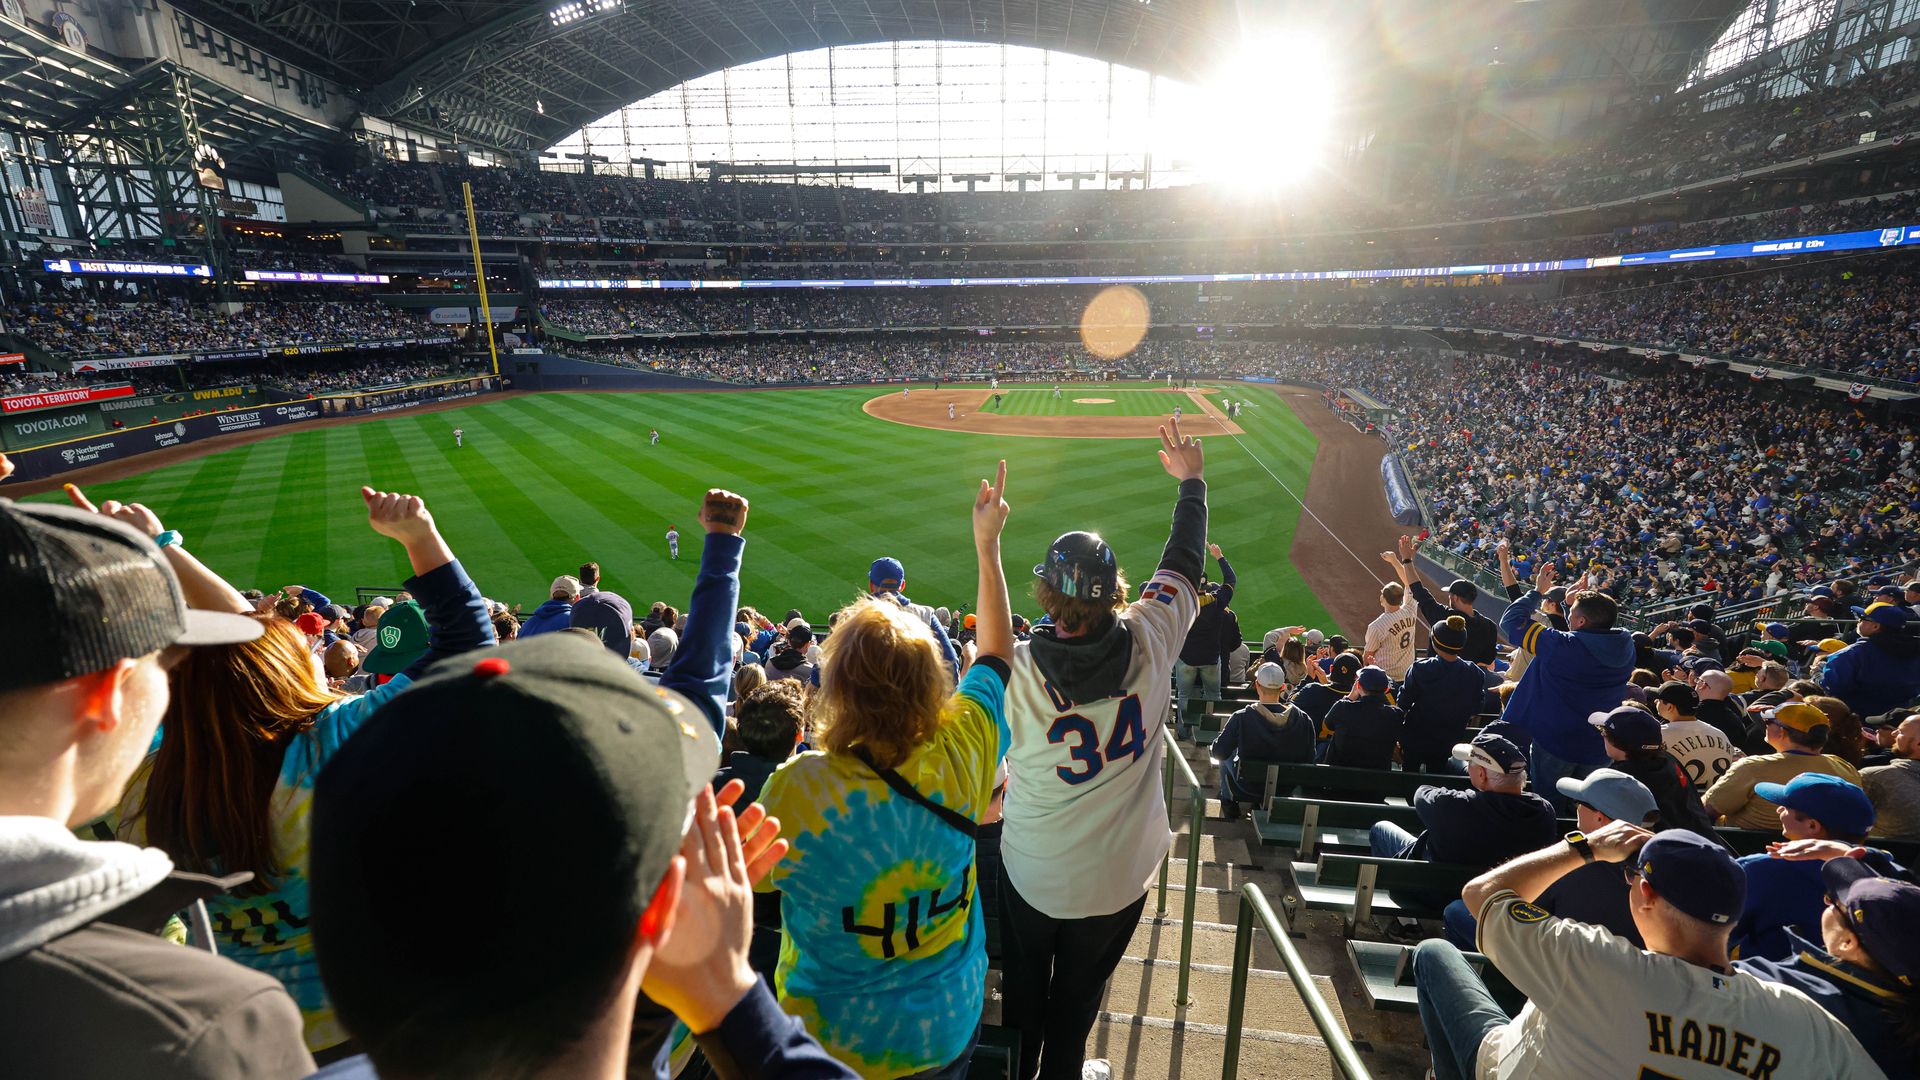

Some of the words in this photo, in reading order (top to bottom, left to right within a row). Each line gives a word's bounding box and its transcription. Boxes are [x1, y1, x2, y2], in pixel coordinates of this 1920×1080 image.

[66, 28, 81, 47] 19
[25, 201, 47, 213] LEINIE
[28, 213, 51, 226] LODGE
[79, 262, 107, 272] TASTE
[284, 347, 299, 355] 620
[300, 346, 321, 354] WTMJ
[4, 397, 43, 410] TOYOTA
[43, 390, 90, 404] TERRITORY
[193, 387, 242, 400] UWM.EDU
[287, 405, 306, 413] Aurora
[288, 412, 306, 420] Health
[14, 414, 88, 435] TOYOTA.COM
[216, 411, 260, 425] WINTRUST
[154, 431, 174, 441] Johnson
[160, 437, 180, 447] Controls
[75, 441, 115, 455] Northwestern
[78, 451, 99, 462] Mutual
[1400, 631, 1411, 649] 8
[1046, 693, 1147, 785] 34
[1672, 735, 1732, 757] FIELDER
[1684, 757, 1731, 790] 28
[842, 864, 970, 960] 414
[1644, 1011, 1782, 1080] HADER
